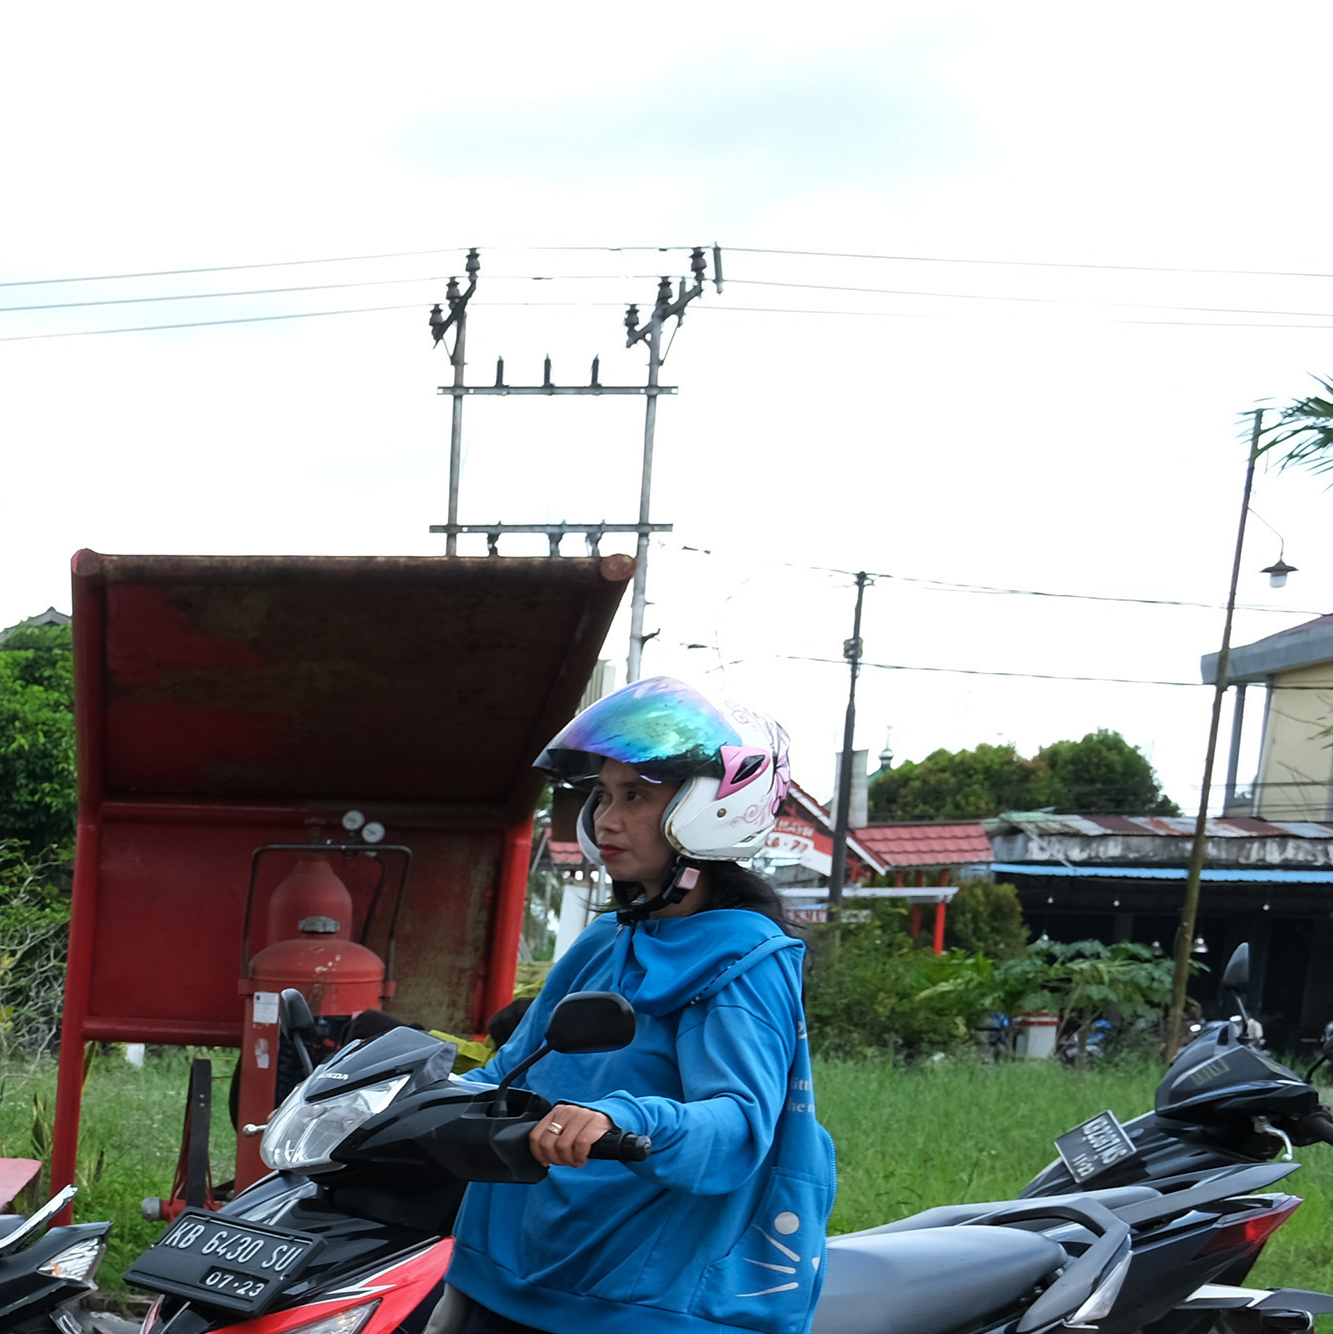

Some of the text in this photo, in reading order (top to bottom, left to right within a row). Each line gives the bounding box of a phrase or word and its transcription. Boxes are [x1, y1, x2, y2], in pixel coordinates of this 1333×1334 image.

[165, 1222, 303, 1272] KB 6430 SU
